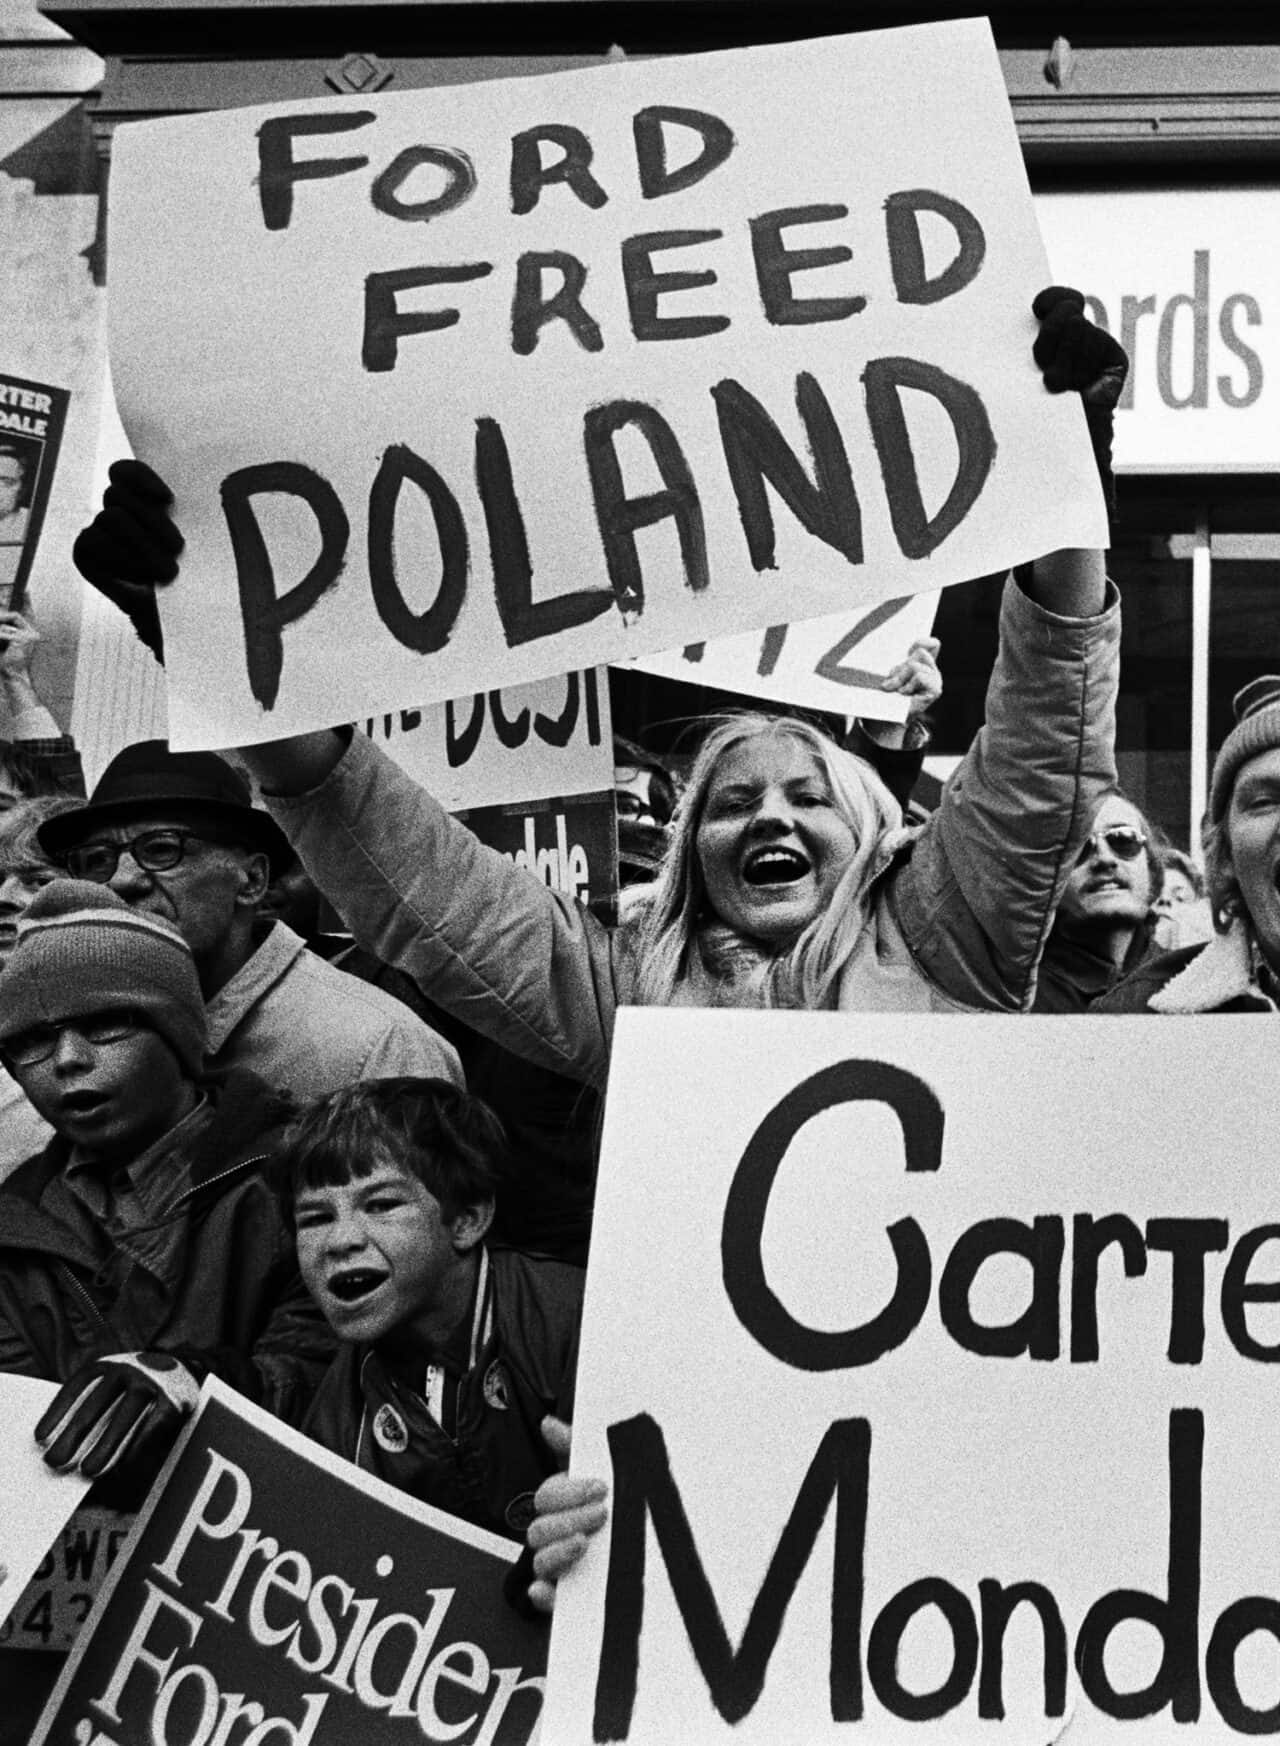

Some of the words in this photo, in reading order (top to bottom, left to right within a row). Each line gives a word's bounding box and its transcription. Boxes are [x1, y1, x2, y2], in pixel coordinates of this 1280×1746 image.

[257, 105, 735, 231] FORD
[362, 188, 986, 371] FREED
[220, 355, 998, 712] POLAND
